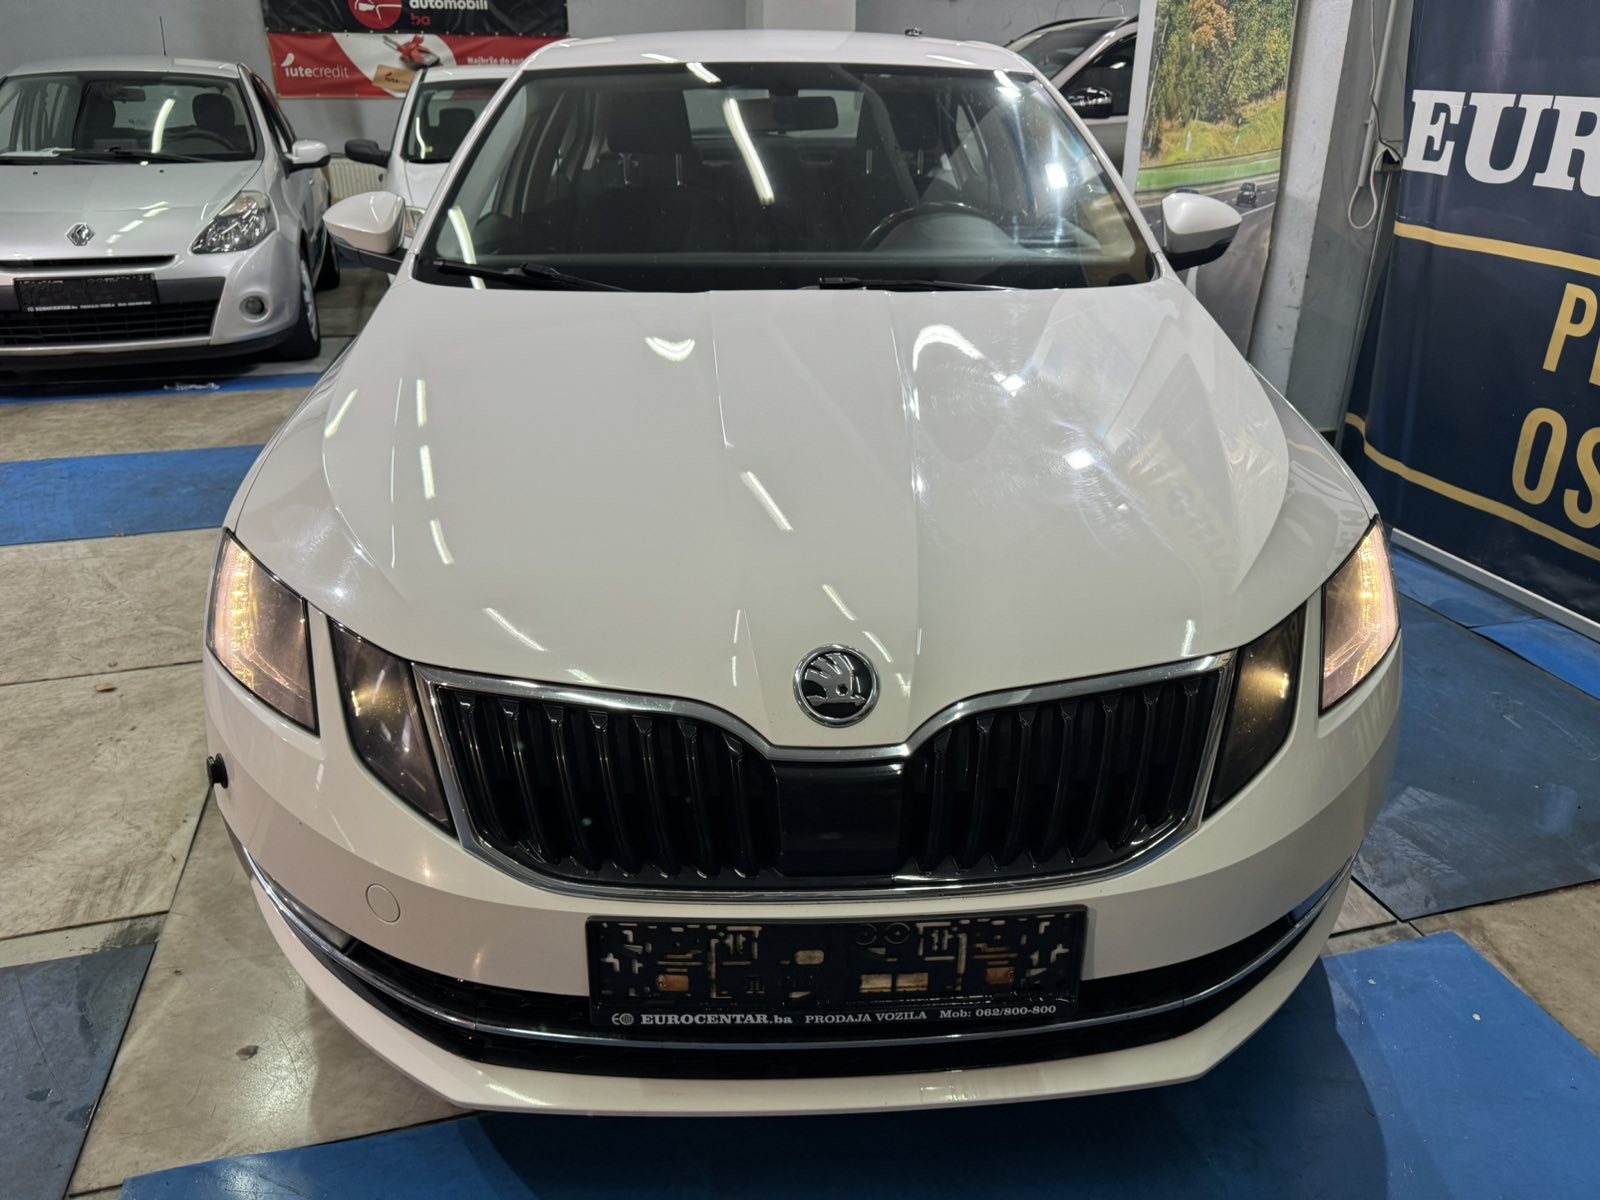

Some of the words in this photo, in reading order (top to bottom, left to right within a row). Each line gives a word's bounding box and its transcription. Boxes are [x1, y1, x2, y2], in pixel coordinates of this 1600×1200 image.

[409, 0, 488, 10] automobili
[1542, 282, 1600, 386] P
[641, 1013, 793, 1025] EUROCENTAR.ba
[804, 1012, 872, 1024] PRODAJA
[875, 1011, 927, 1022] VOZILA
[939, 1008, 971, 1019] Mob:
[975, 1005, 1057, 1018] 062/800-800
